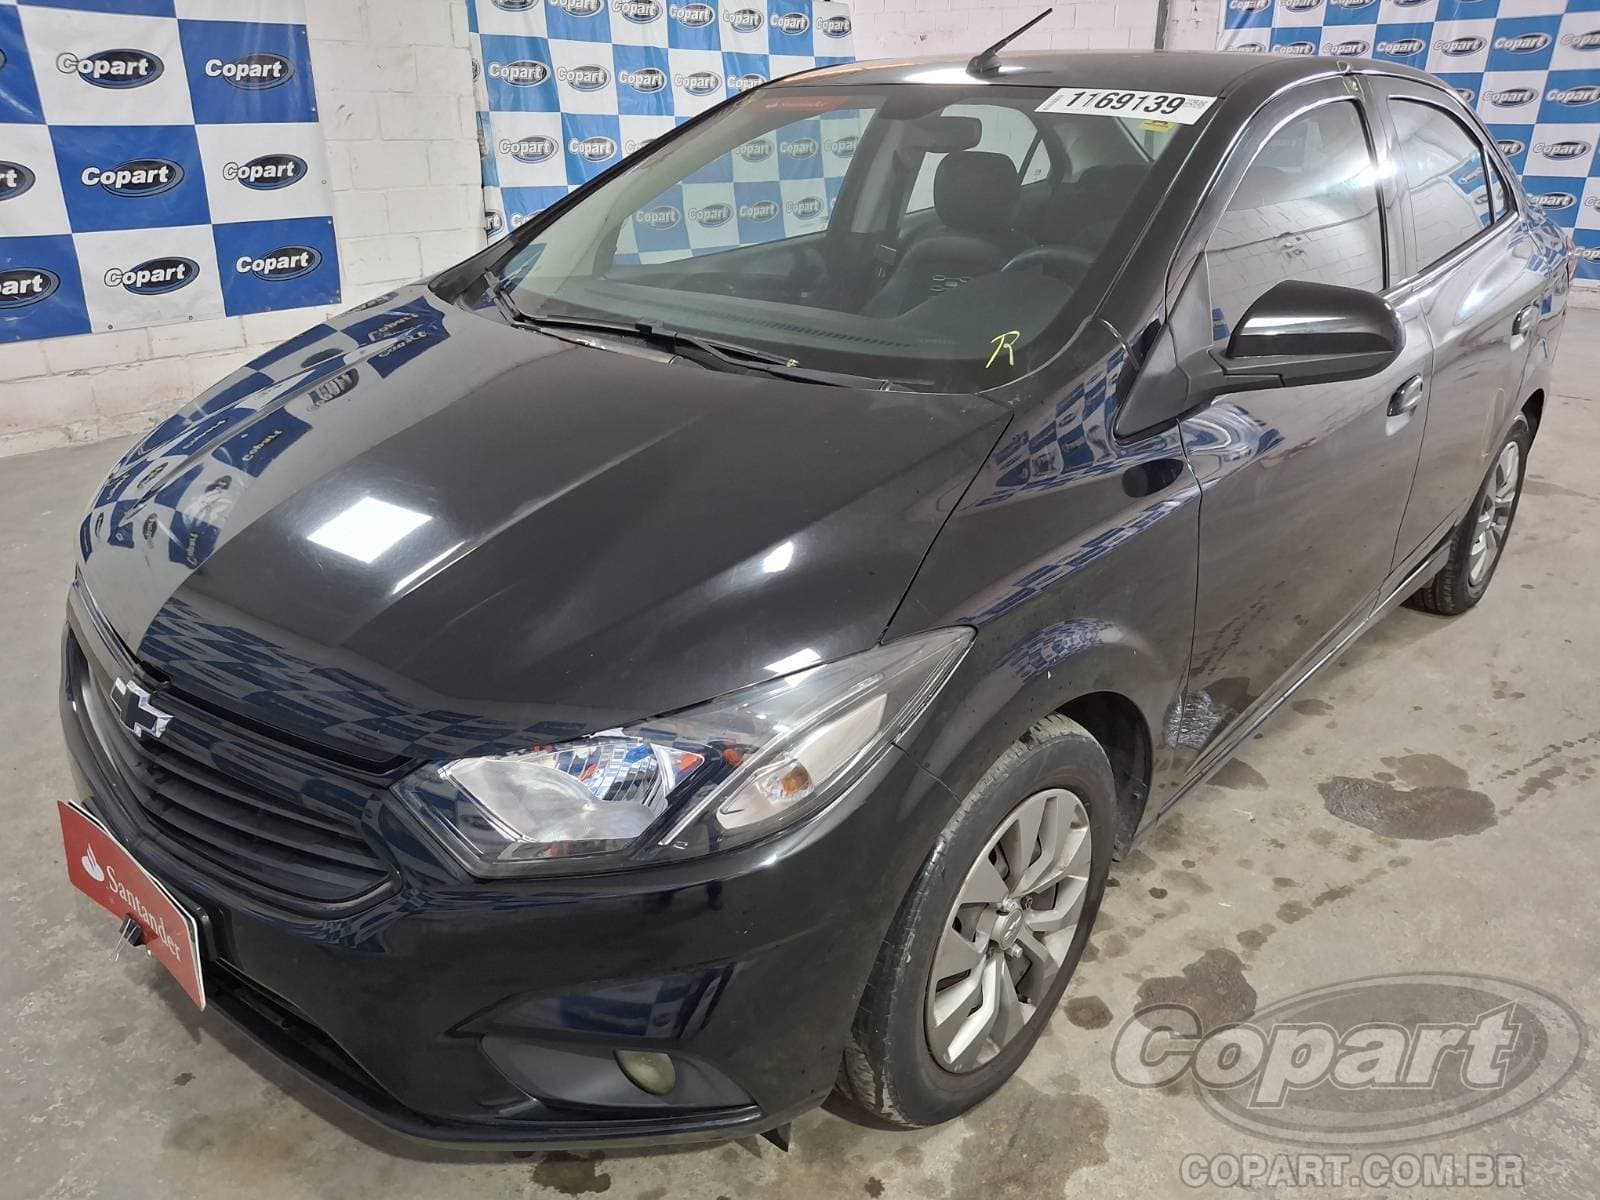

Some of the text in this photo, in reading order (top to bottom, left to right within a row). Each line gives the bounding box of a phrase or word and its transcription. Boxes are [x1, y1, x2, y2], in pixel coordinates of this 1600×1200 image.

[612, 1, 657, 16] Copart
[669, 4, 710, 20] Copart
[723, 10, 760, 26] Copart
[770, 14, 806, 29] Copart
[816, 18, 850, 32] Copart
[1434, 39, 1480, 53] Copart
[1494, 35, 1544, 49] Copart
[1561, 33, 1600, 47] Copa
[1324, 43, 1364, 55] Copart
[1376, 41, 1419, 55] Copart
[56, 52, 149, 78] Copart
[205, 59, 282, 80] Copart
[488, 63, 544, 80] Copart
[557, 66, 604, 83] Copart
[619, 71, 662, 86] Copart
[675, 74, 717, 89] Copart
[1066, 91, 1185, 115] 1169139
[1483, 89, 1530, 104] Copart
[499, 138, 550, 156] Copart
[569, 138, 610, 155] Copart
[780, 141, 814, 155] Copart
[1533, 142, 1583, 155] Copart
[81, 164, 169, 188] Copart
[223, 161, 294, 180] Copart
[688, 207, 727, 222] Copart
[739, 205, 775, 220] Copart
[785, 200, 819, 214] Copart
[636, 211, 676, 226] Copart
[235, 251, 309, 276] Copart
[104, 263, 187, 289] Copart
[0, 279, 43, 296] art
[985, 331, 1020, 368] R
[107, 866, 180, 961] Santander
